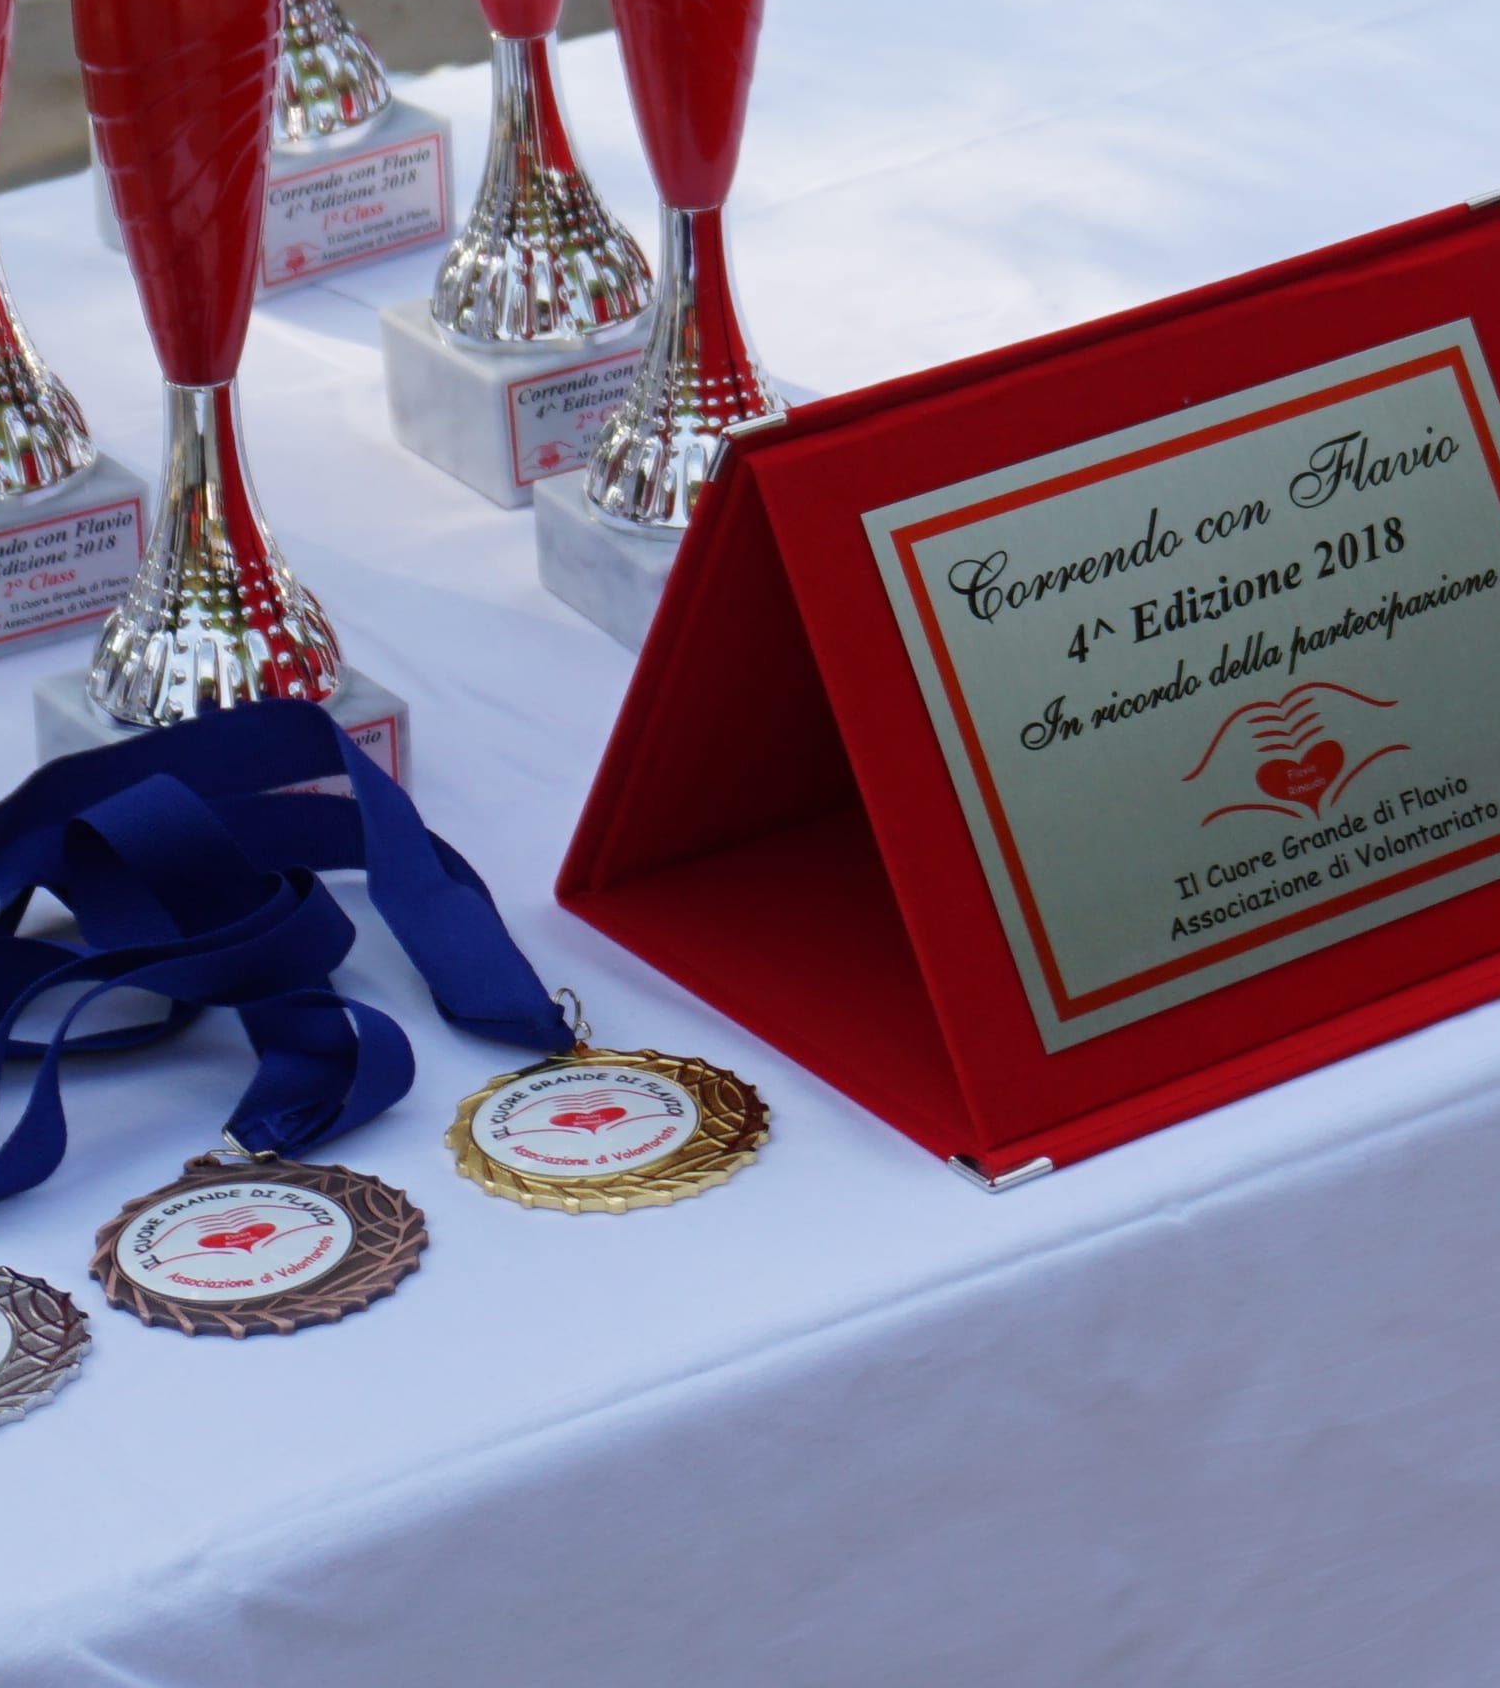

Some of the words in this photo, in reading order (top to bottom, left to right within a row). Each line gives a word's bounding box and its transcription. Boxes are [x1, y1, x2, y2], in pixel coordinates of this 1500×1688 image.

[270, 174, 343, 206] Correndo
[348, 165, 376, 183] con
[382, 148, 431, 171] Flavio
[310, 184, 375, 213] Edizione
[382, 170, 417, 191] 2018
[344, 202, 385, 225] Class
[518, 373, 598, 405] Correndo
[603, 365, 633, 382] con
[536, 403, 556, 419] 4^
[575, 412, 594, 430] 2°
[34, 530, 67, 548] con
[76, 512, 133, 538] Flavio
[946, 506, 1184, 624] Correndo
[1193, 499, 1271, 544] con
[1288, 425, 1460, 509] Flavio
[74, 535, 117, 559] 2018
[4, 579, 23, 598] 2°
[28, 570, 76, 591] Class
[1066, 616, 1116, 664] 4^
[1128, 561, 1302, 644] Edizione
[1313, 515, 1405, 580] 2018
[1019, 694, 1084, 751] In
[1089, 658, 1202, 729] ricordo
[1207, 630, 1283, 687] della
[1287, 567, 1498, 675] partecipazione
[1173, 871, 1200, 900] Il
[1206, 850, 1276, 888] Cuore
[1281, 813, 1368, 860] Grande
[1372, 798, 1395, 825] di
[1398, 776, 1468, 816] Flavio
[1170, 870, 1322, 941] Associazione
[1327, 853, 1350, 879] di
[1354, 802, 1498, 867] Volontariato
[529, 1073, 607, 1092] GRANDE
[615, 1074, 637, 1084] DI
[491, 1091, 530, 1125] CUORE
[641, 1081, 684, 1117] FLAVIO
[492, 1127, 511, 1141] IL
[510, 1145, 589, 1166] Associazione
[595, 1154, 608, 1164] di
[612, 1126, 677, 1161] Volontariato
[162, 1189, 241, 1216] GRANDE
[251, 1190, 276, 1199] DI
[282, 1192, 334, 1225] FLAVIO
[134, 1217, 164, 1254] CUORE
[141, 1254, 162, 1270] IL
[165, 1272, 254, 1288] Associazione
[260, 1273, 274, 1284] di
[277, 1234, 334, 1278] Volontariato
